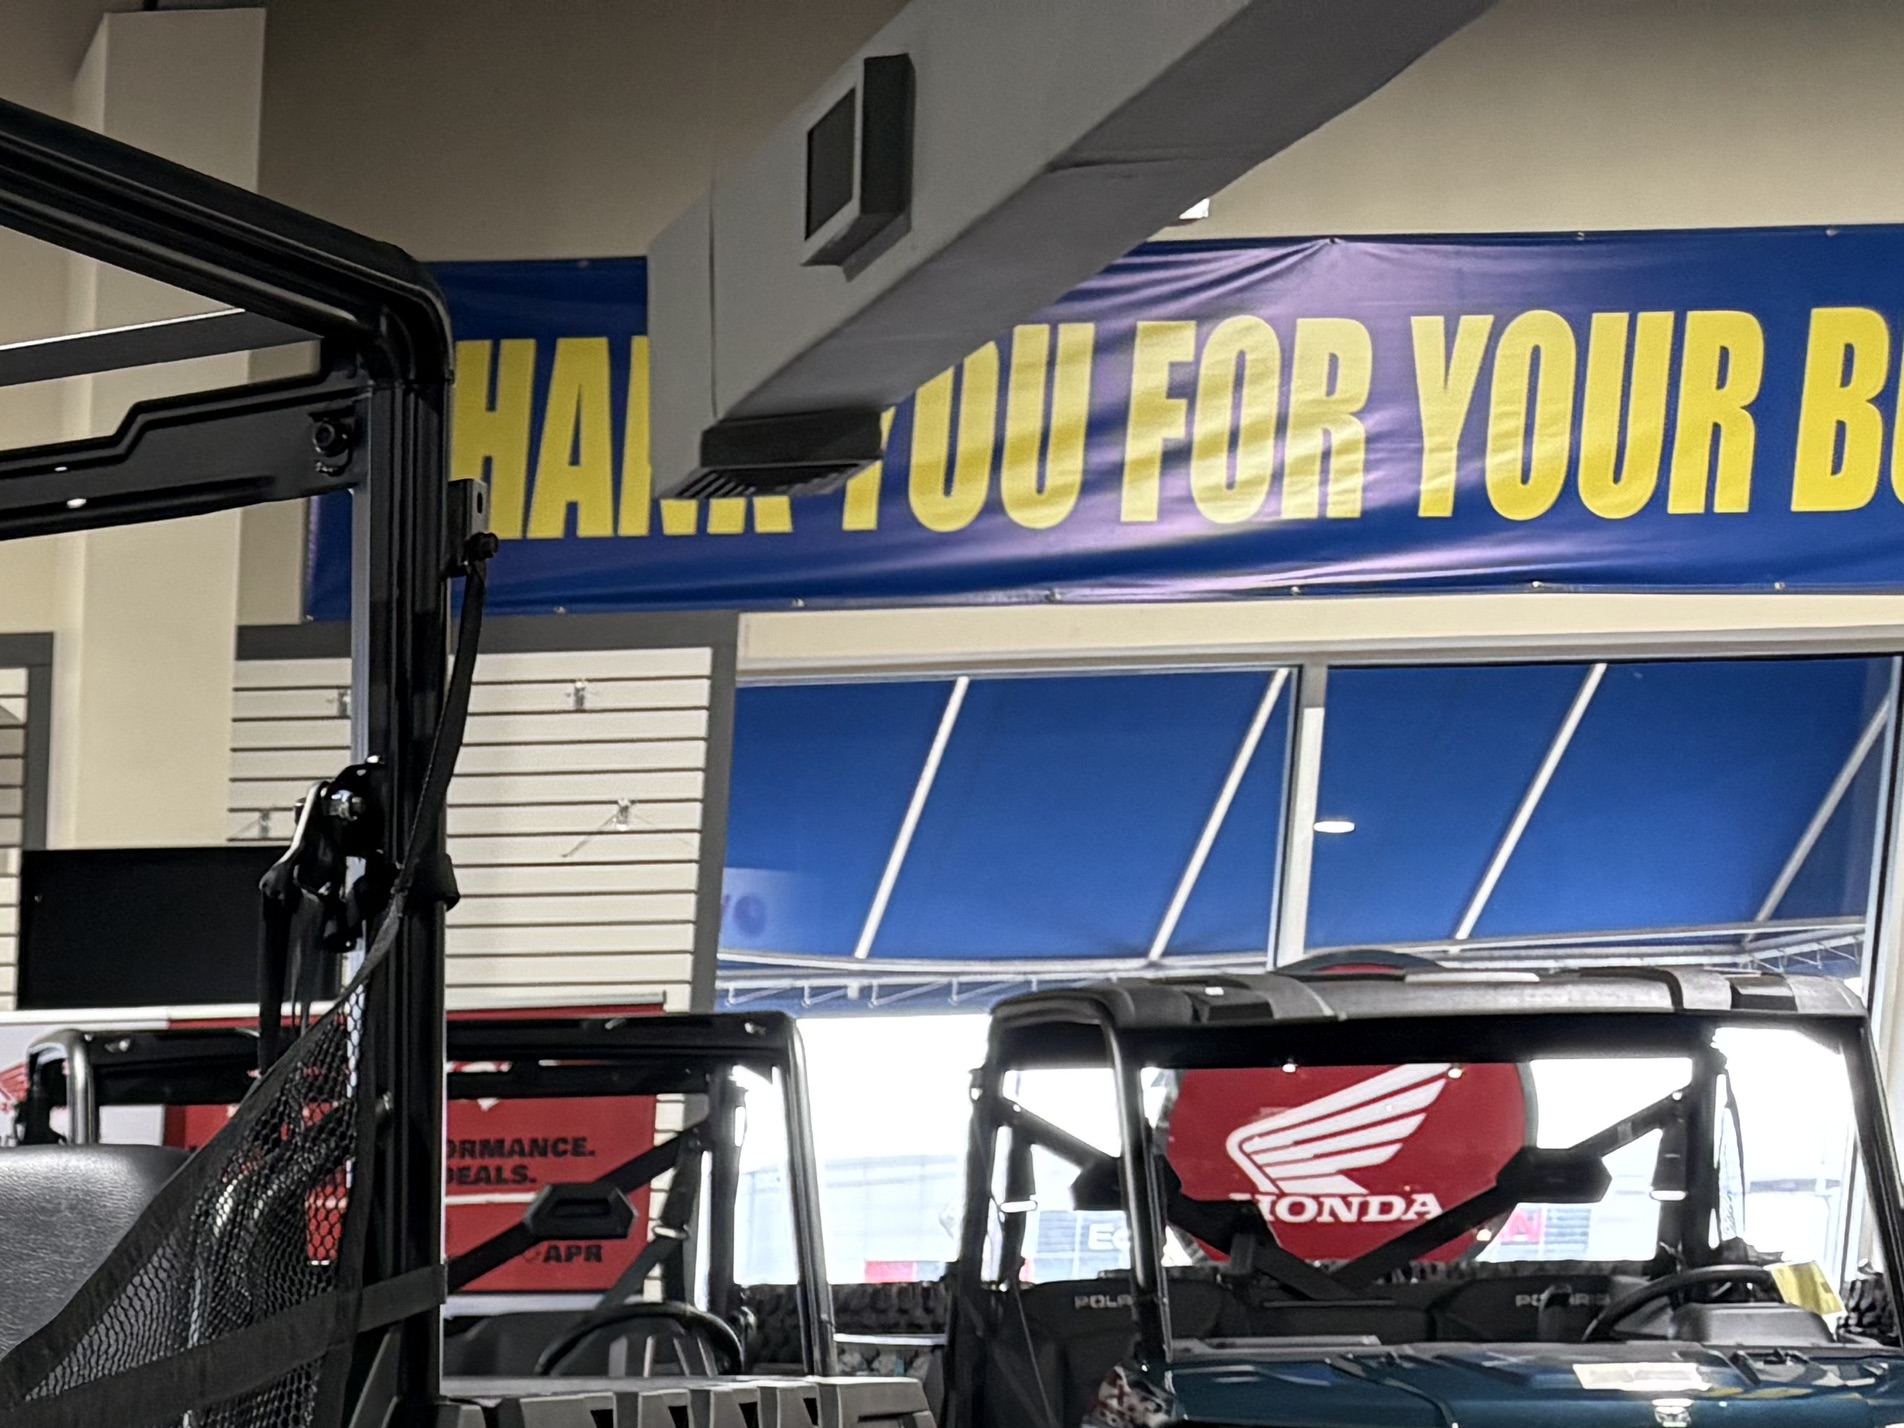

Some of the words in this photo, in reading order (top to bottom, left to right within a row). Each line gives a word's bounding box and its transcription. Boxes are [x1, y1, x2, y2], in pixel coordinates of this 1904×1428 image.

[1120, 314, 1373, 524] FOR
[1408, 309, 1764, 521] YOUR
[1791, 306, 1904, 512] B
[544, 1244, 603, 1263] APR
